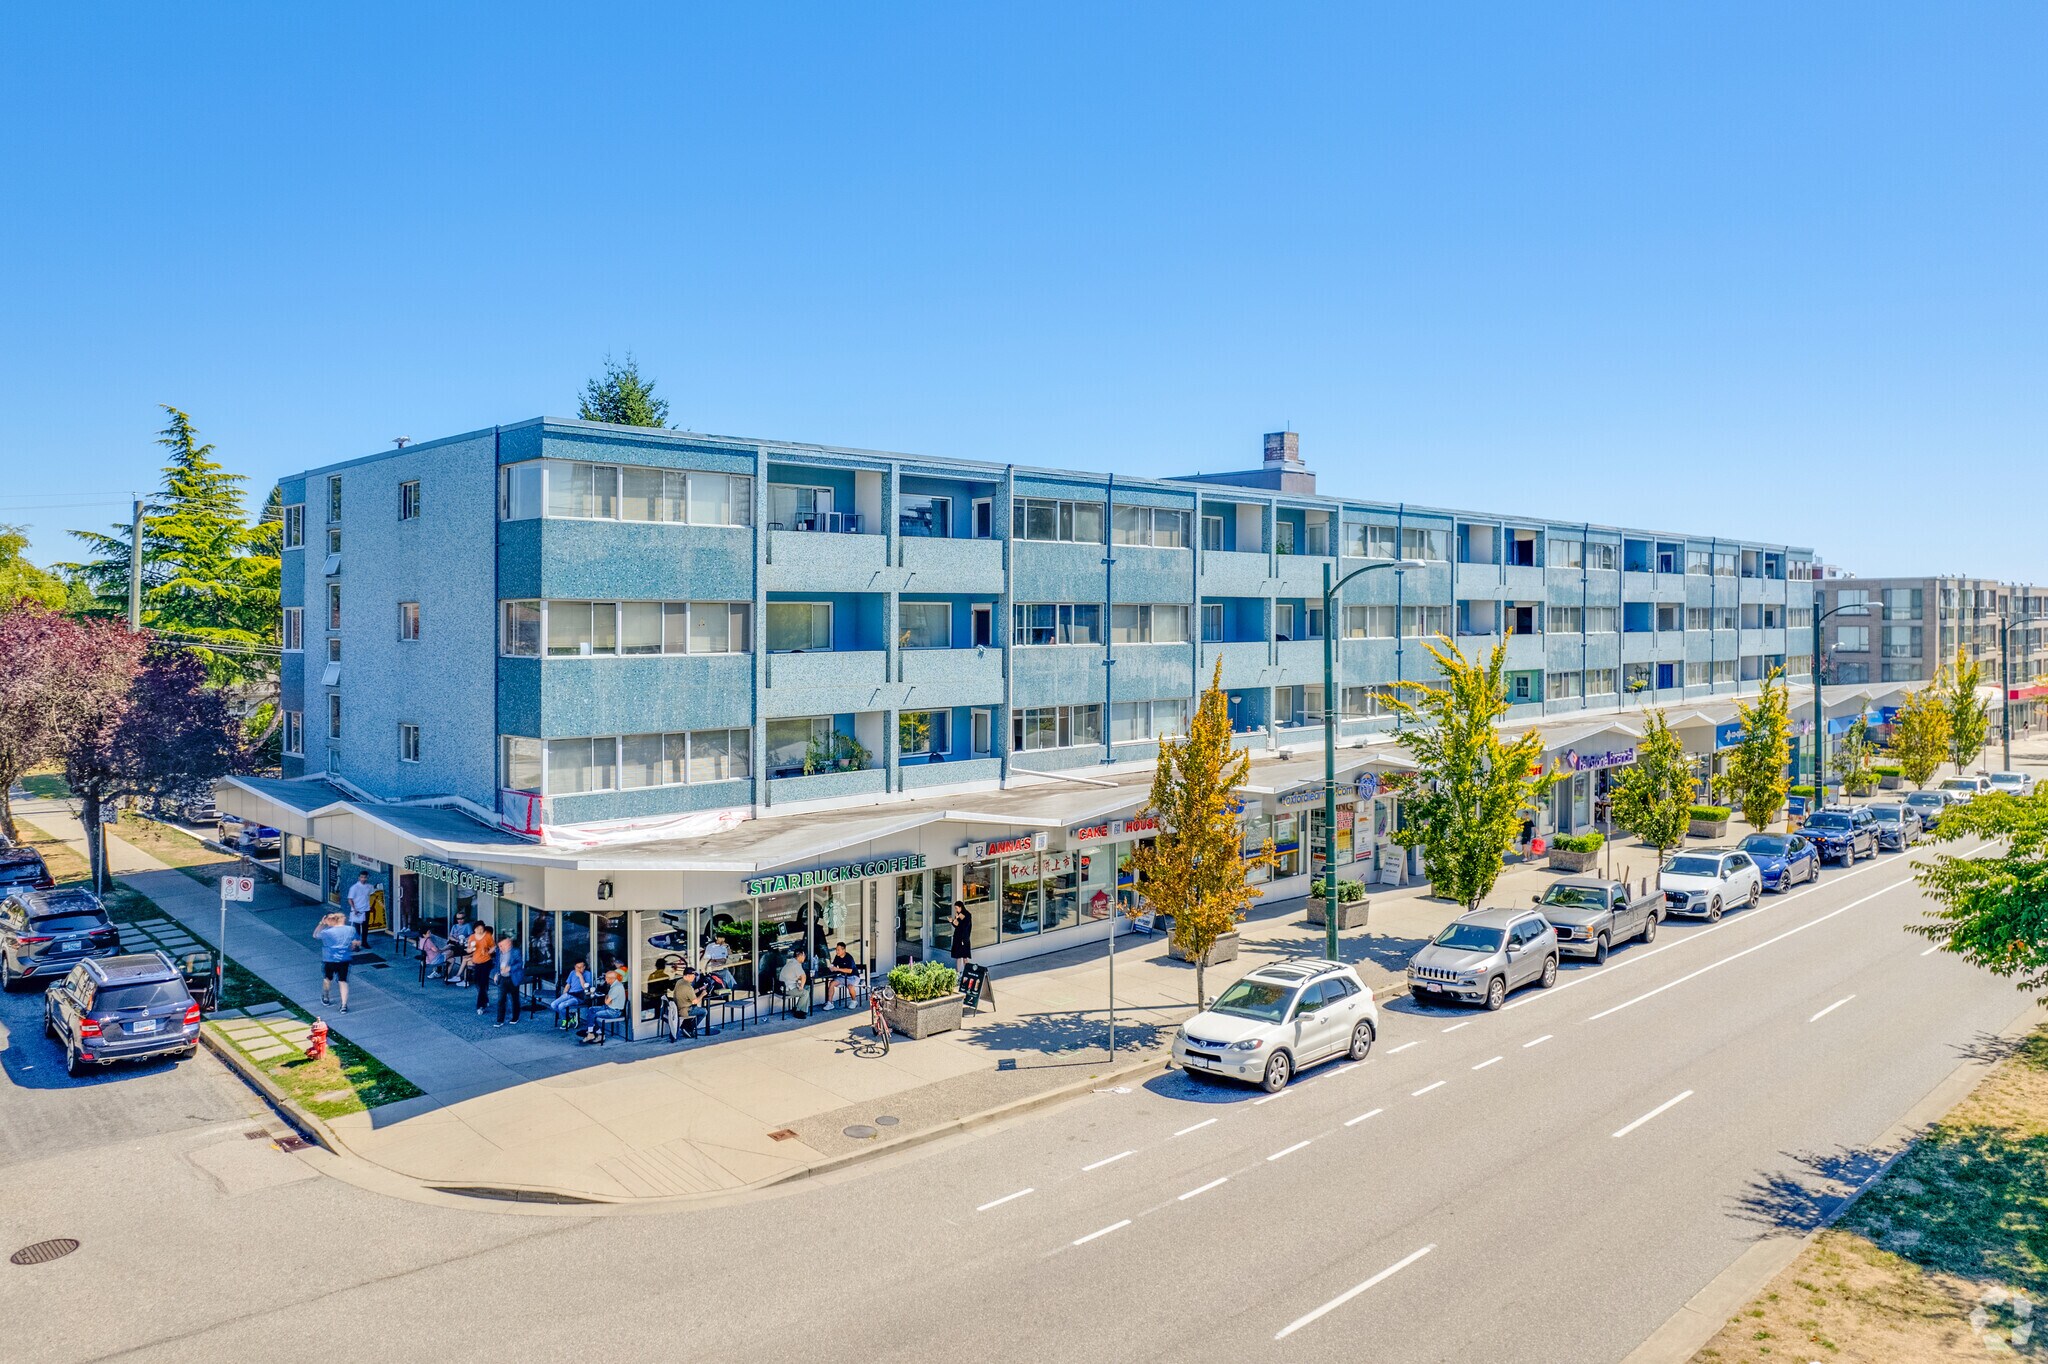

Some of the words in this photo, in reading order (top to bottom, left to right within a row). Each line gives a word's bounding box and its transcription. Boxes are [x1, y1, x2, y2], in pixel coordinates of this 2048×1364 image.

[1284, 786, 1352, 806] oxfordlearn.com
[1078, 825, 1108, 841] CAKE
[988, 837, 1031, 856] ANNA'S
[404, 856, 458, 885] STARBUCKS
[460, 871, 499, 897] COFFEE
[750, 864, 861, 896] STARBUCKS
[864, 854, 927, 877] COFFEE
